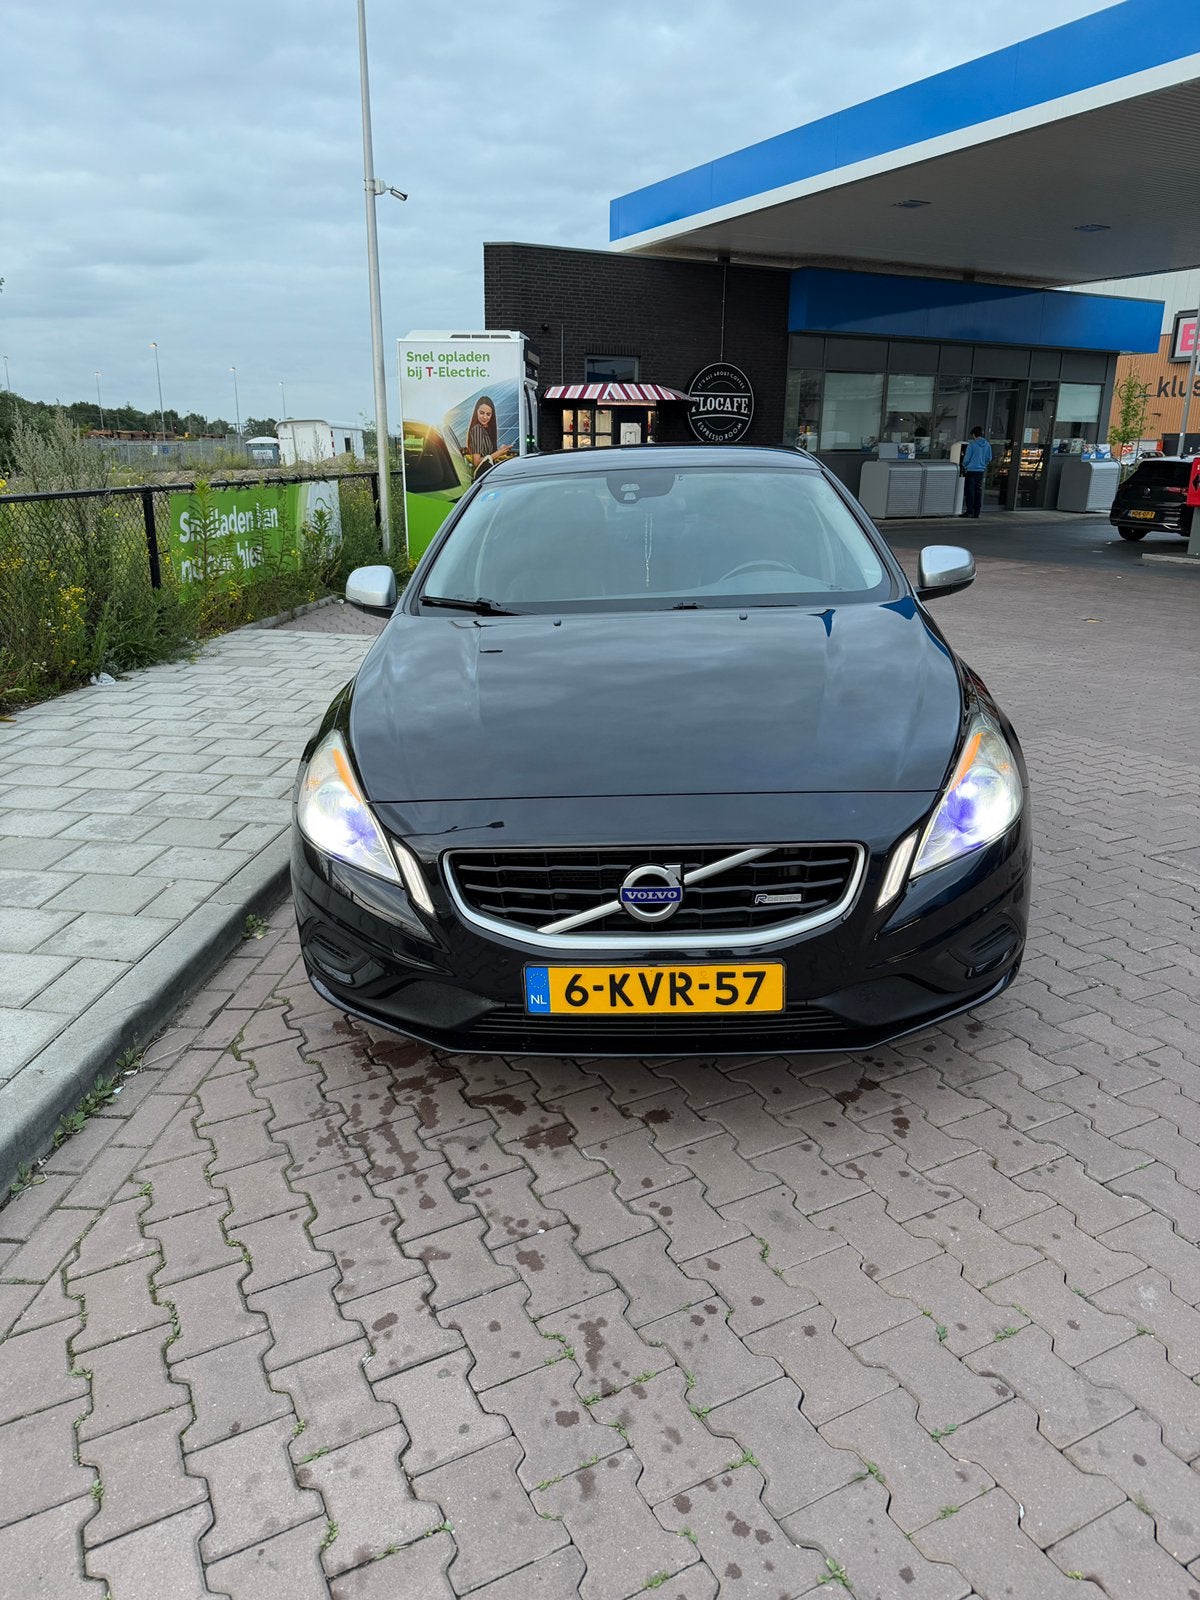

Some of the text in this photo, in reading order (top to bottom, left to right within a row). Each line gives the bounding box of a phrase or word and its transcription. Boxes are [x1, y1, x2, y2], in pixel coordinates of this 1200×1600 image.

[406, 351, 490, 364] Snel opladen
[407, 367, 490, 379] bij T-Electric.
[697, 421, 742, 441] ESPRESSO ROOM
[180, 505, 254, 543] Snlladen
[625, 889, 678, 900] VOLVO
[530, 971, 767, 1006] NL 6-KVR-57
